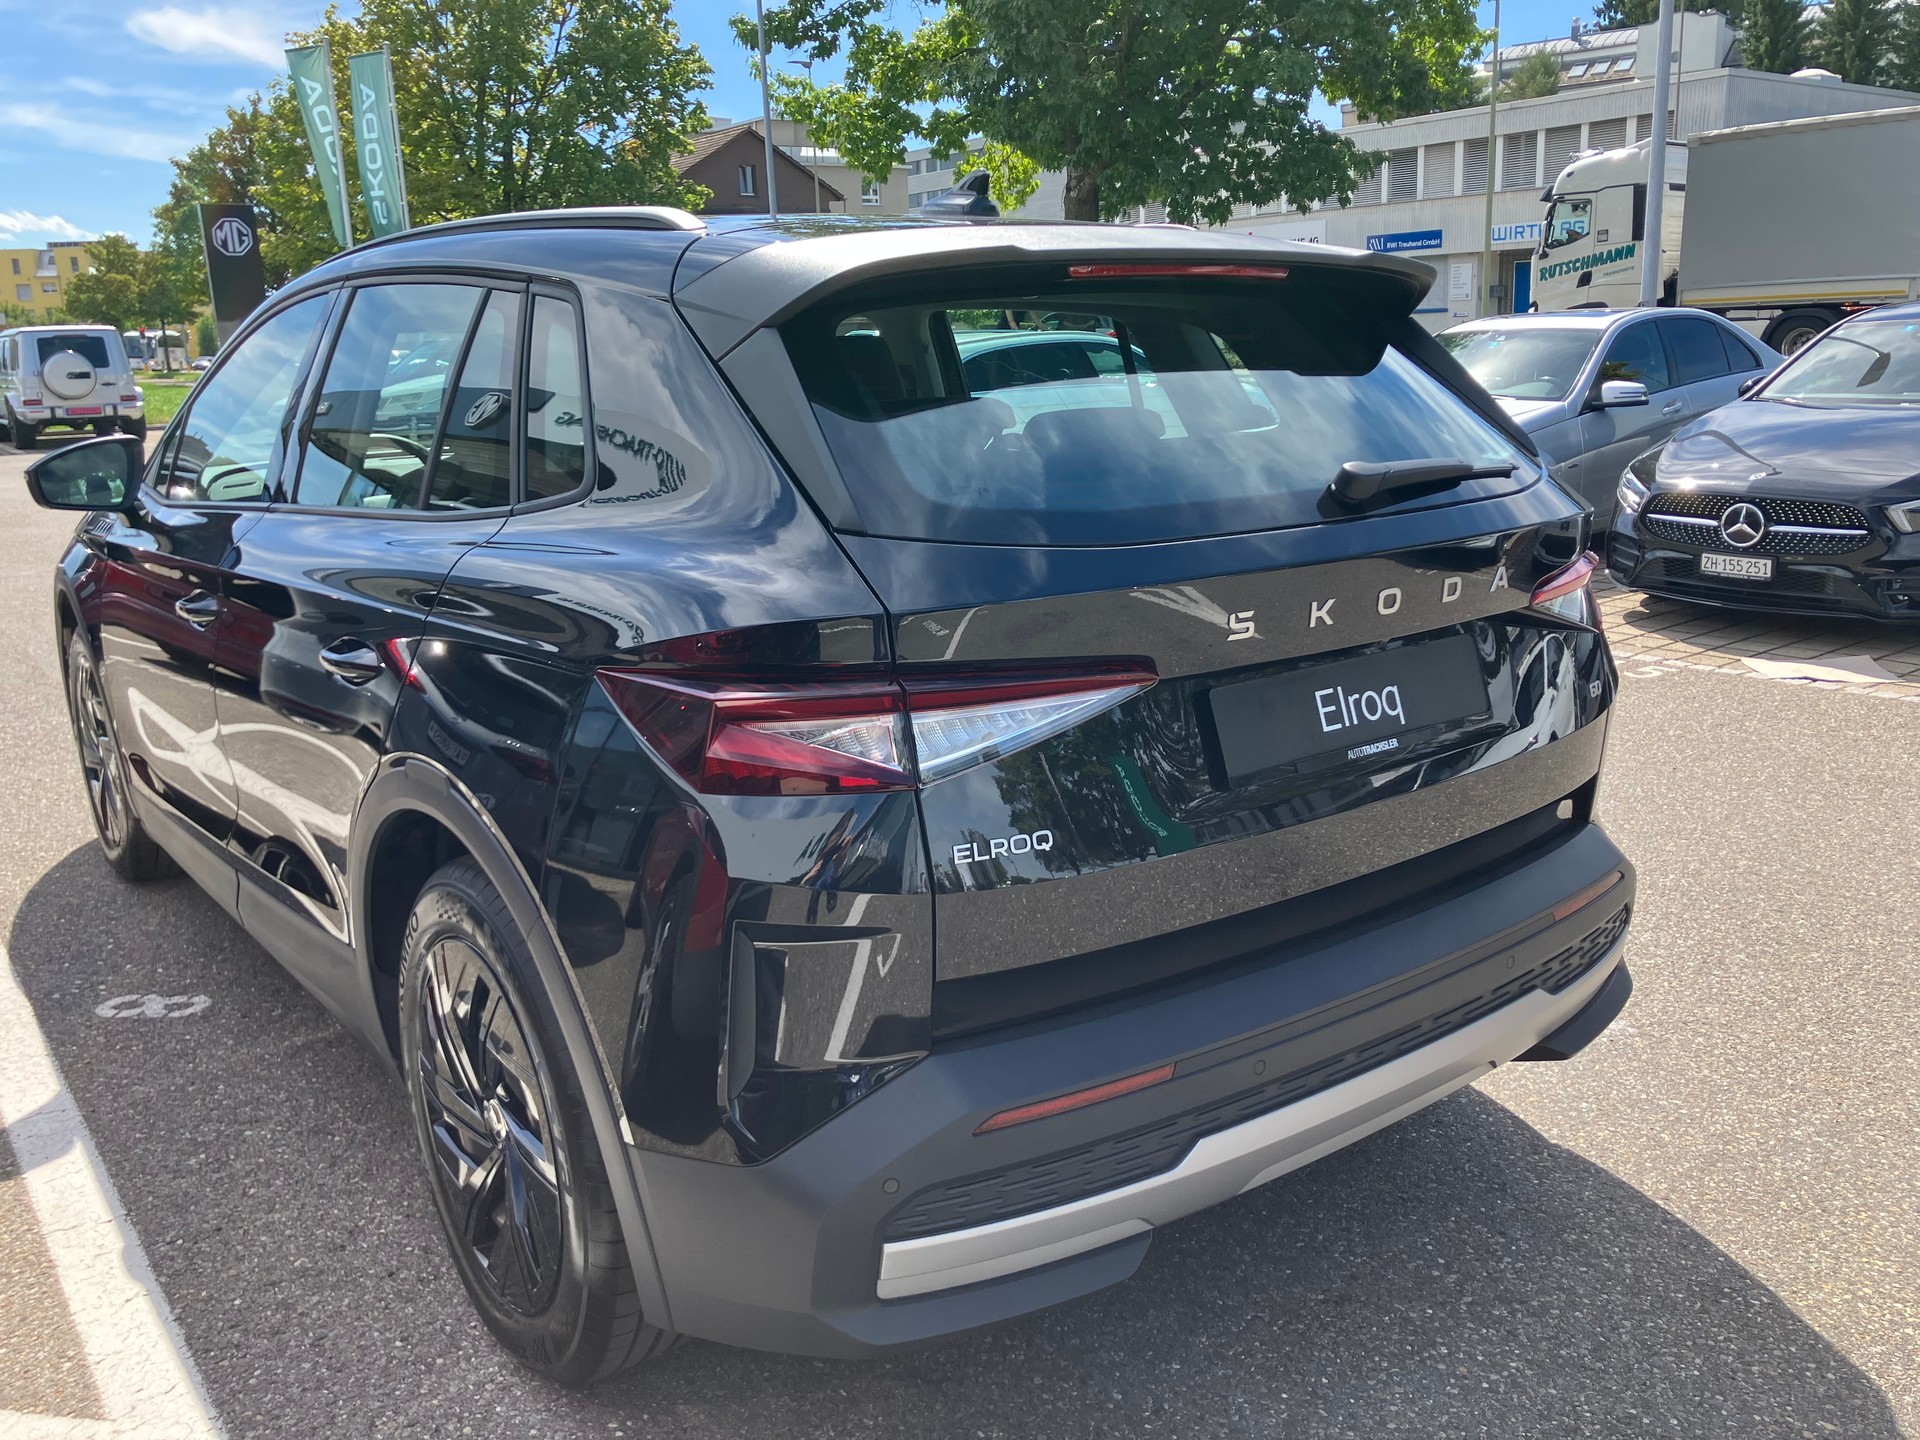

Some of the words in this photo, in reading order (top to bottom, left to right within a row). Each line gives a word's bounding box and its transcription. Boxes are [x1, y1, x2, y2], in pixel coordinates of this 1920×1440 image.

[214, 219, 251, 254] MG
[1398, 240, 1422, 248] Treuhand
[1422, 238, 1440, 246] GmbH
[1539, 243, 1636, 282] RUTSCHMANN
[1589, 680, 1602, 698] 60
[1314, 684, 1406, 732] Elroq
[952, 829, 1054, 865] ELROQ
